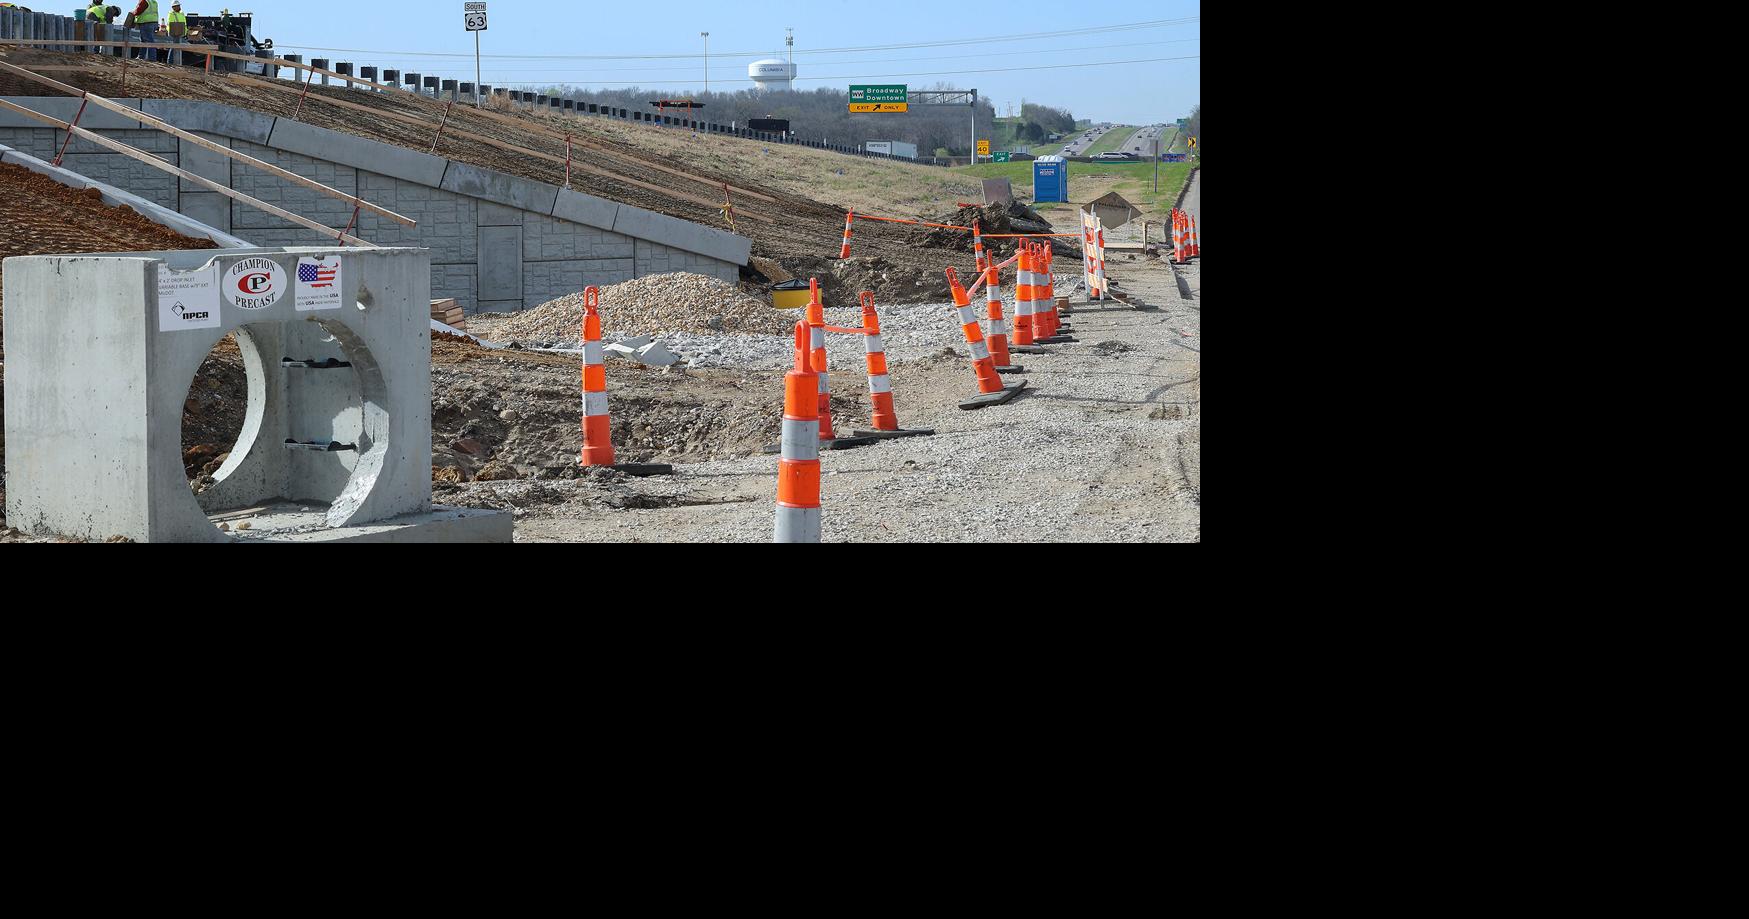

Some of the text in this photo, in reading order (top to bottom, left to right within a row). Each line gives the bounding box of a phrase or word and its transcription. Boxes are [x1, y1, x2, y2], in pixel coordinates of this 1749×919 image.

[467, 16, 485, 27] 63
[232, 258, 275, 276] CHAMPION
[235, 291, 276, 309] PRECAST
[182, 311, 209, 320] NPCA
